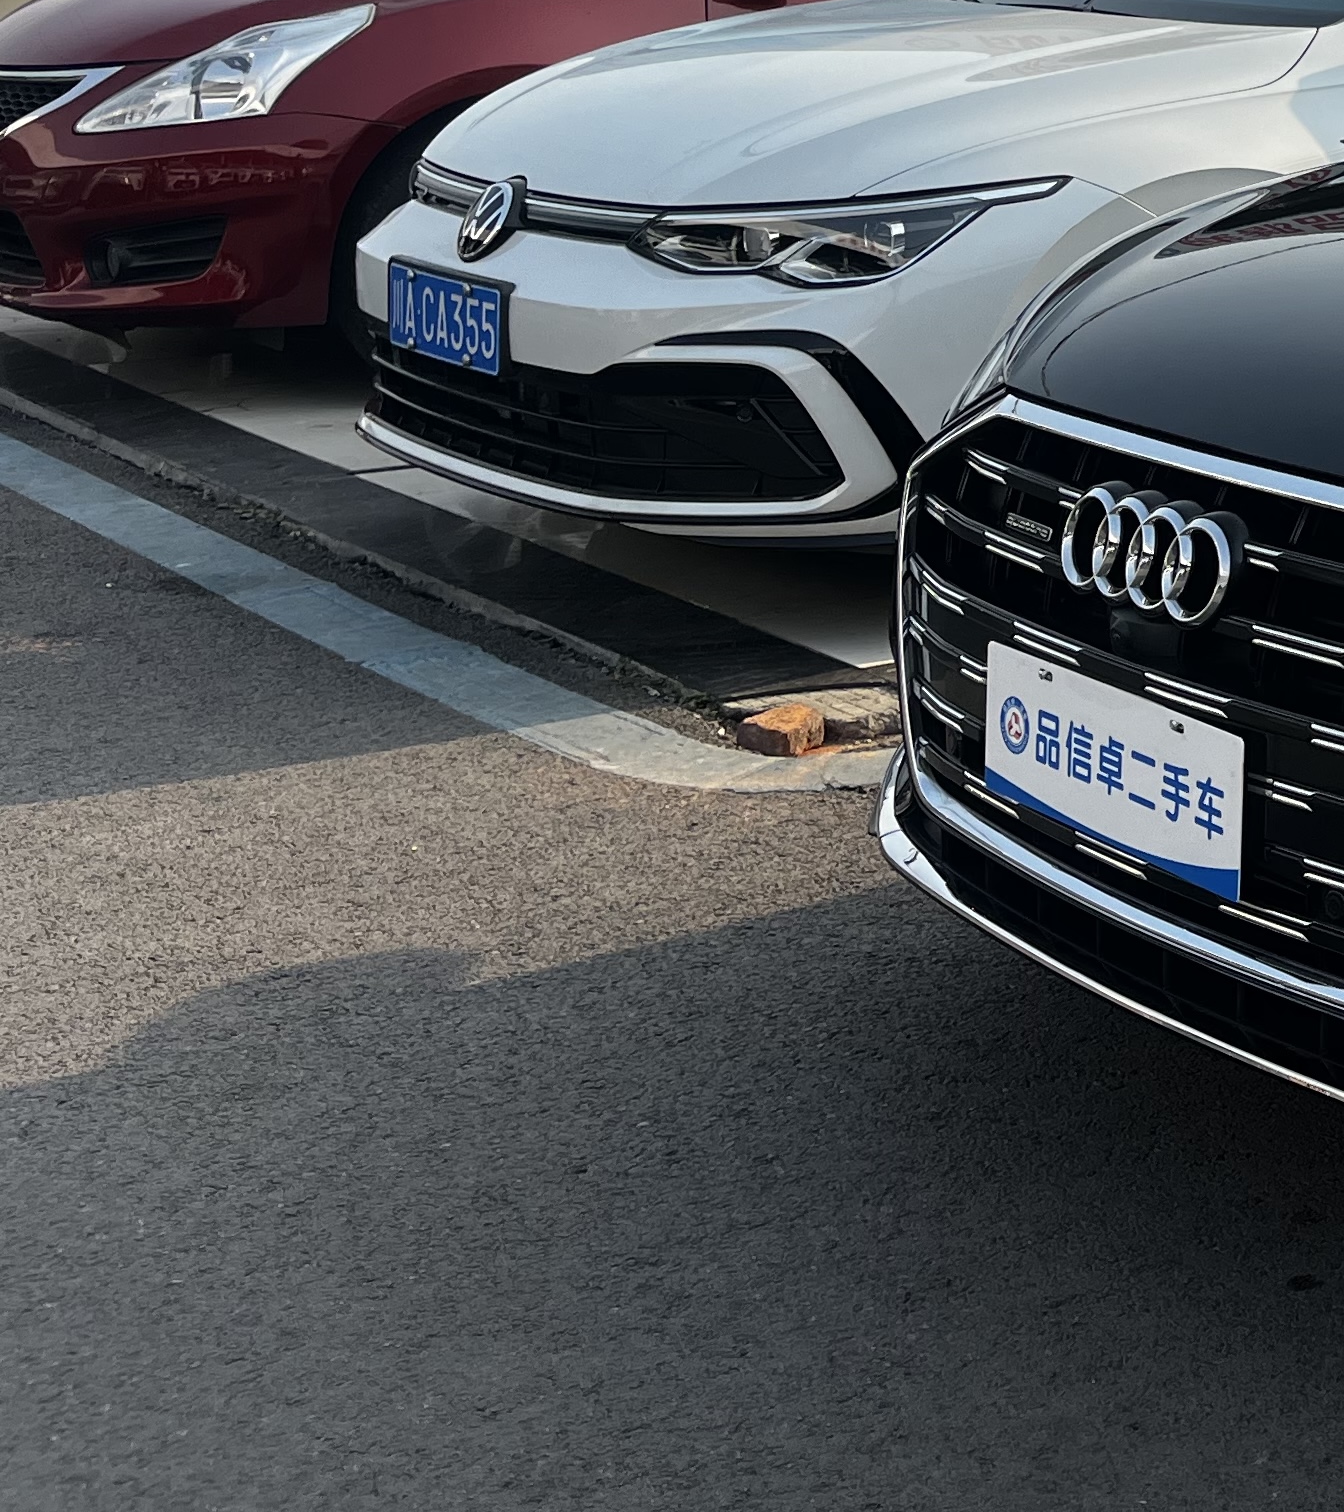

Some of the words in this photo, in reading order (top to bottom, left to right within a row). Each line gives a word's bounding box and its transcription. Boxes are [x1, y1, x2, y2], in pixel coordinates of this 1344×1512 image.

[1035, 708, 1225, 841] 品信卓二手车
